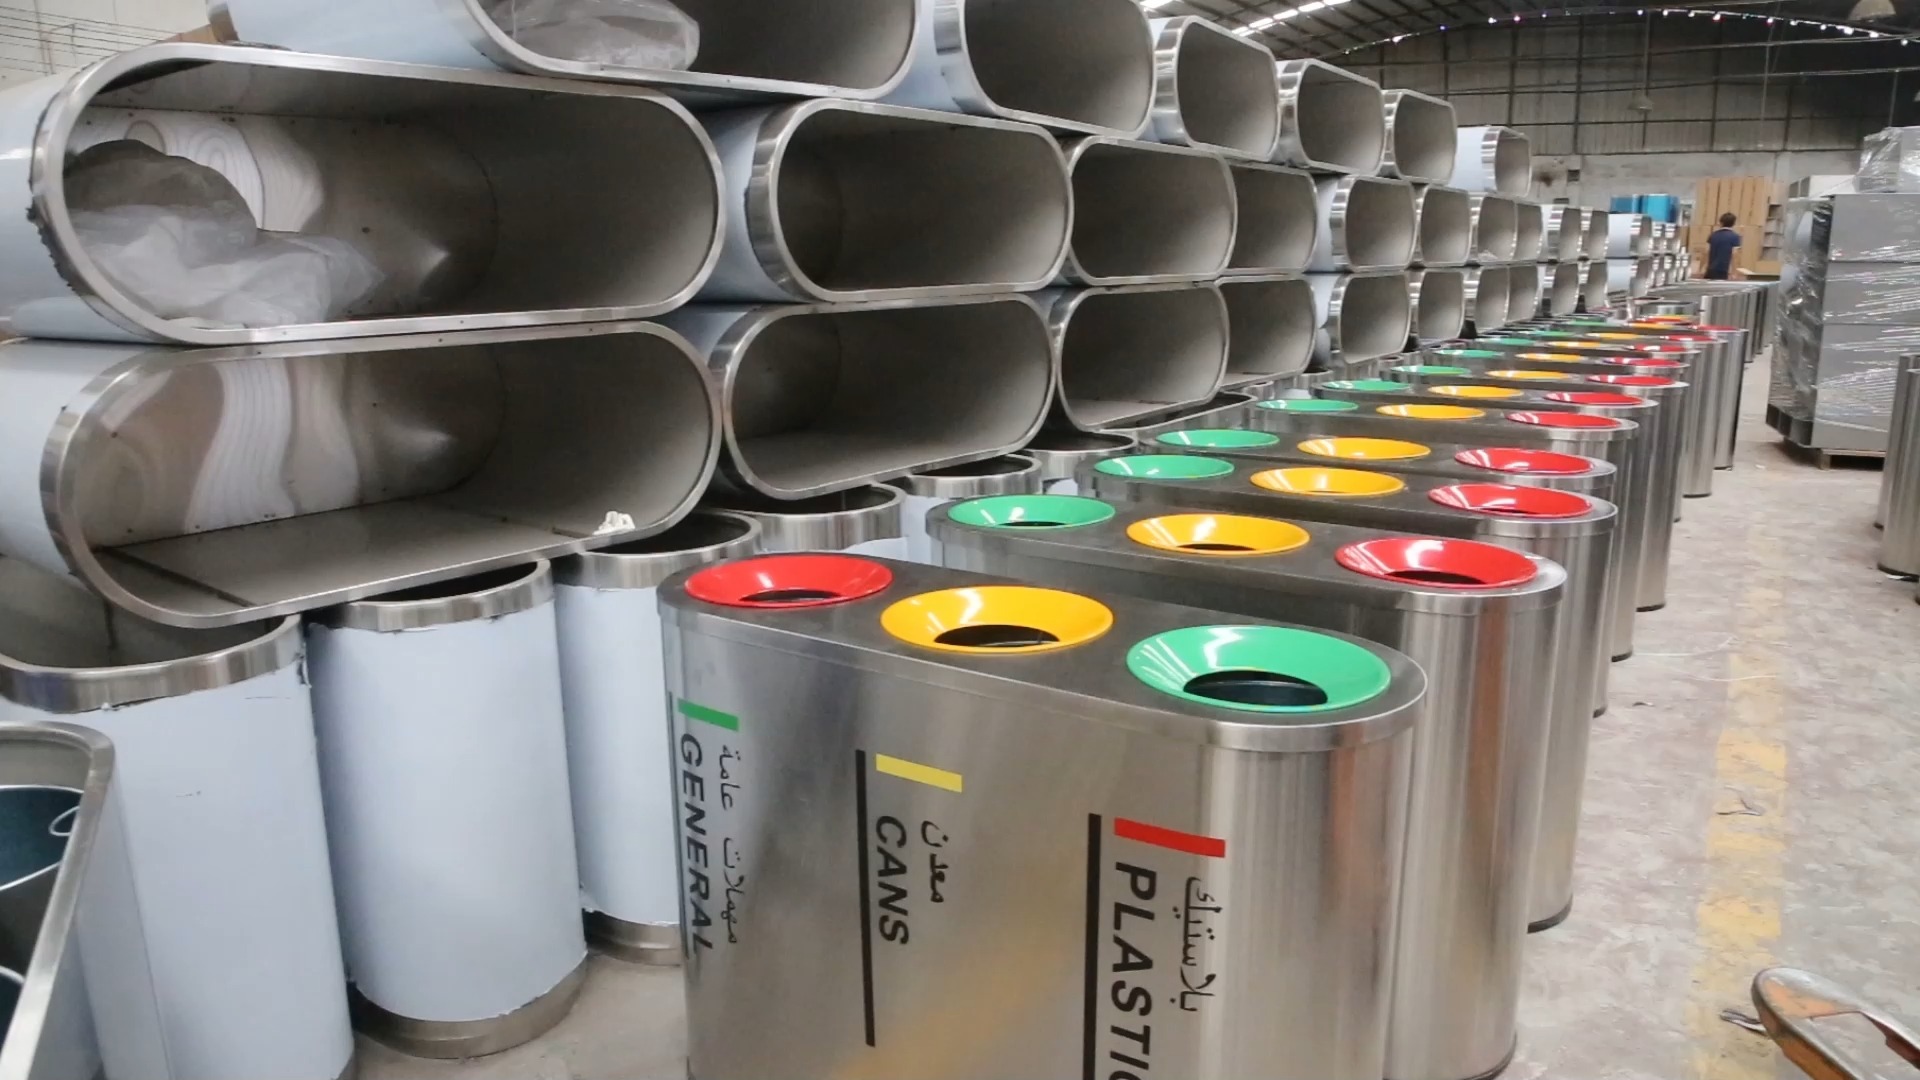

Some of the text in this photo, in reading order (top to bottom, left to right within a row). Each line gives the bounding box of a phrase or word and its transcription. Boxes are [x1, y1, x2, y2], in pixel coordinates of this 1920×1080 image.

[680, 732, 713, 950] GENERAL
[719, 744, 746, 944] مهملات عامة
[875, 815, 910, 945] CANS
[920, 820, 949, 903] معدن
[1169, 876, 1223, 1012] بلاستيك
